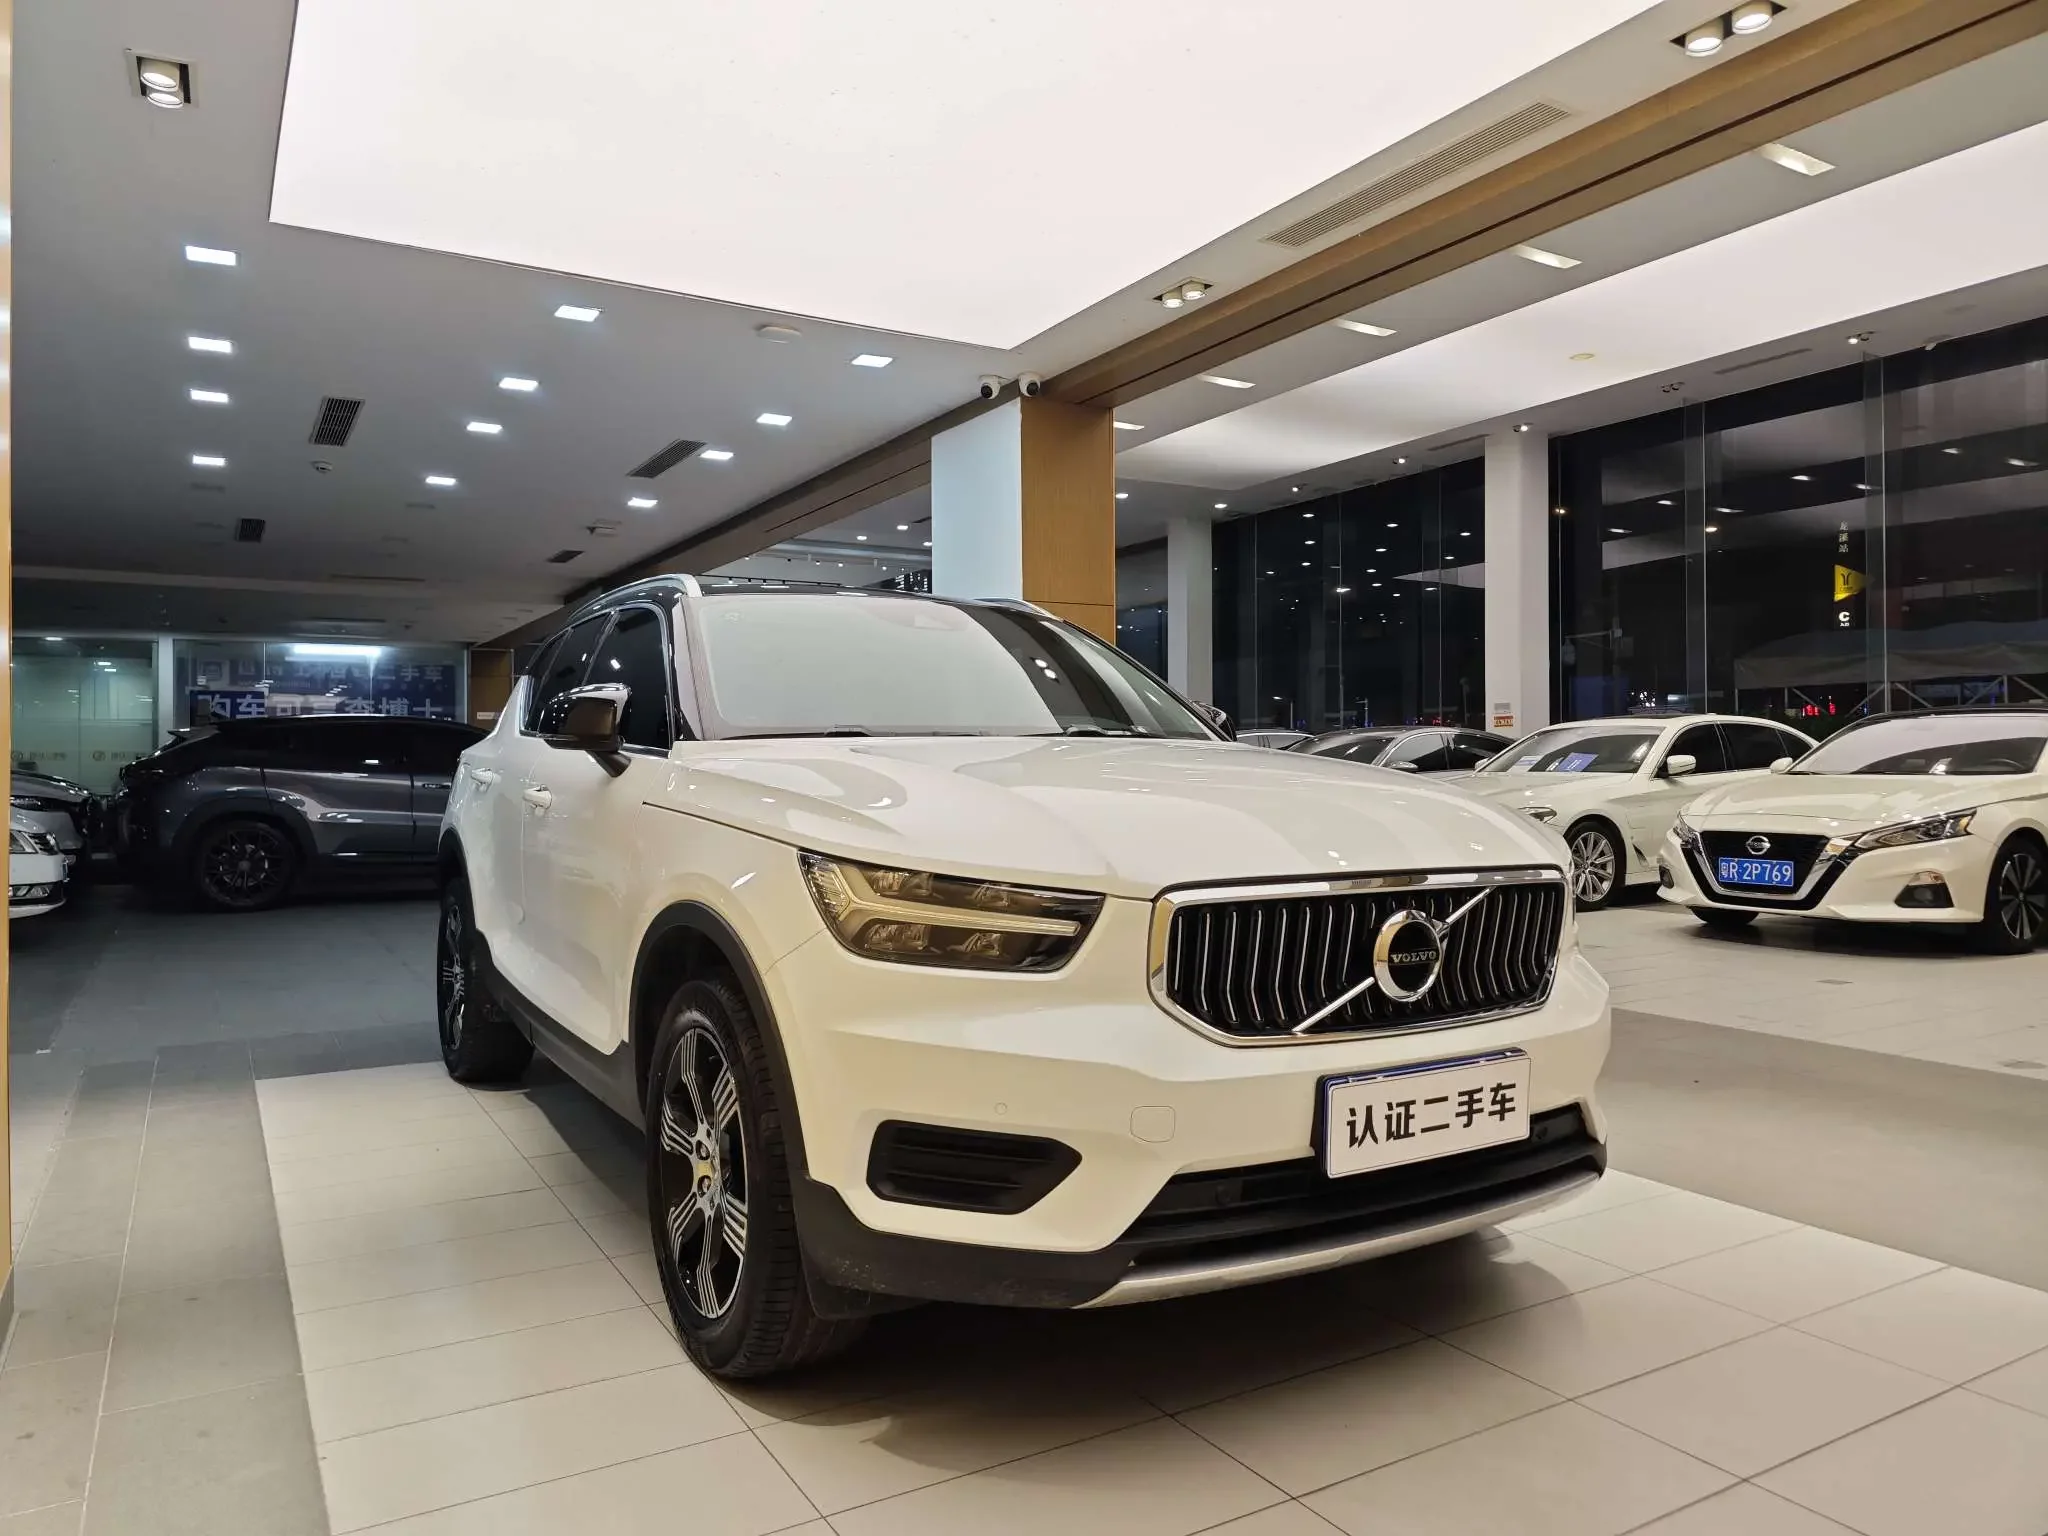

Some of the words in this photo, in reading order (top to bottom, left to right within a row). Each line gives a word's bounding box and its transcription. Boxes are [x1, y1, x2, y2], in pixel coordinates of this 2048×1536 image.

[1839, 611, 1850, 622] C
[1391, 950, 1437, 963] VOLVO
[1346, 1082, 1516, 1149] 认证二手车
